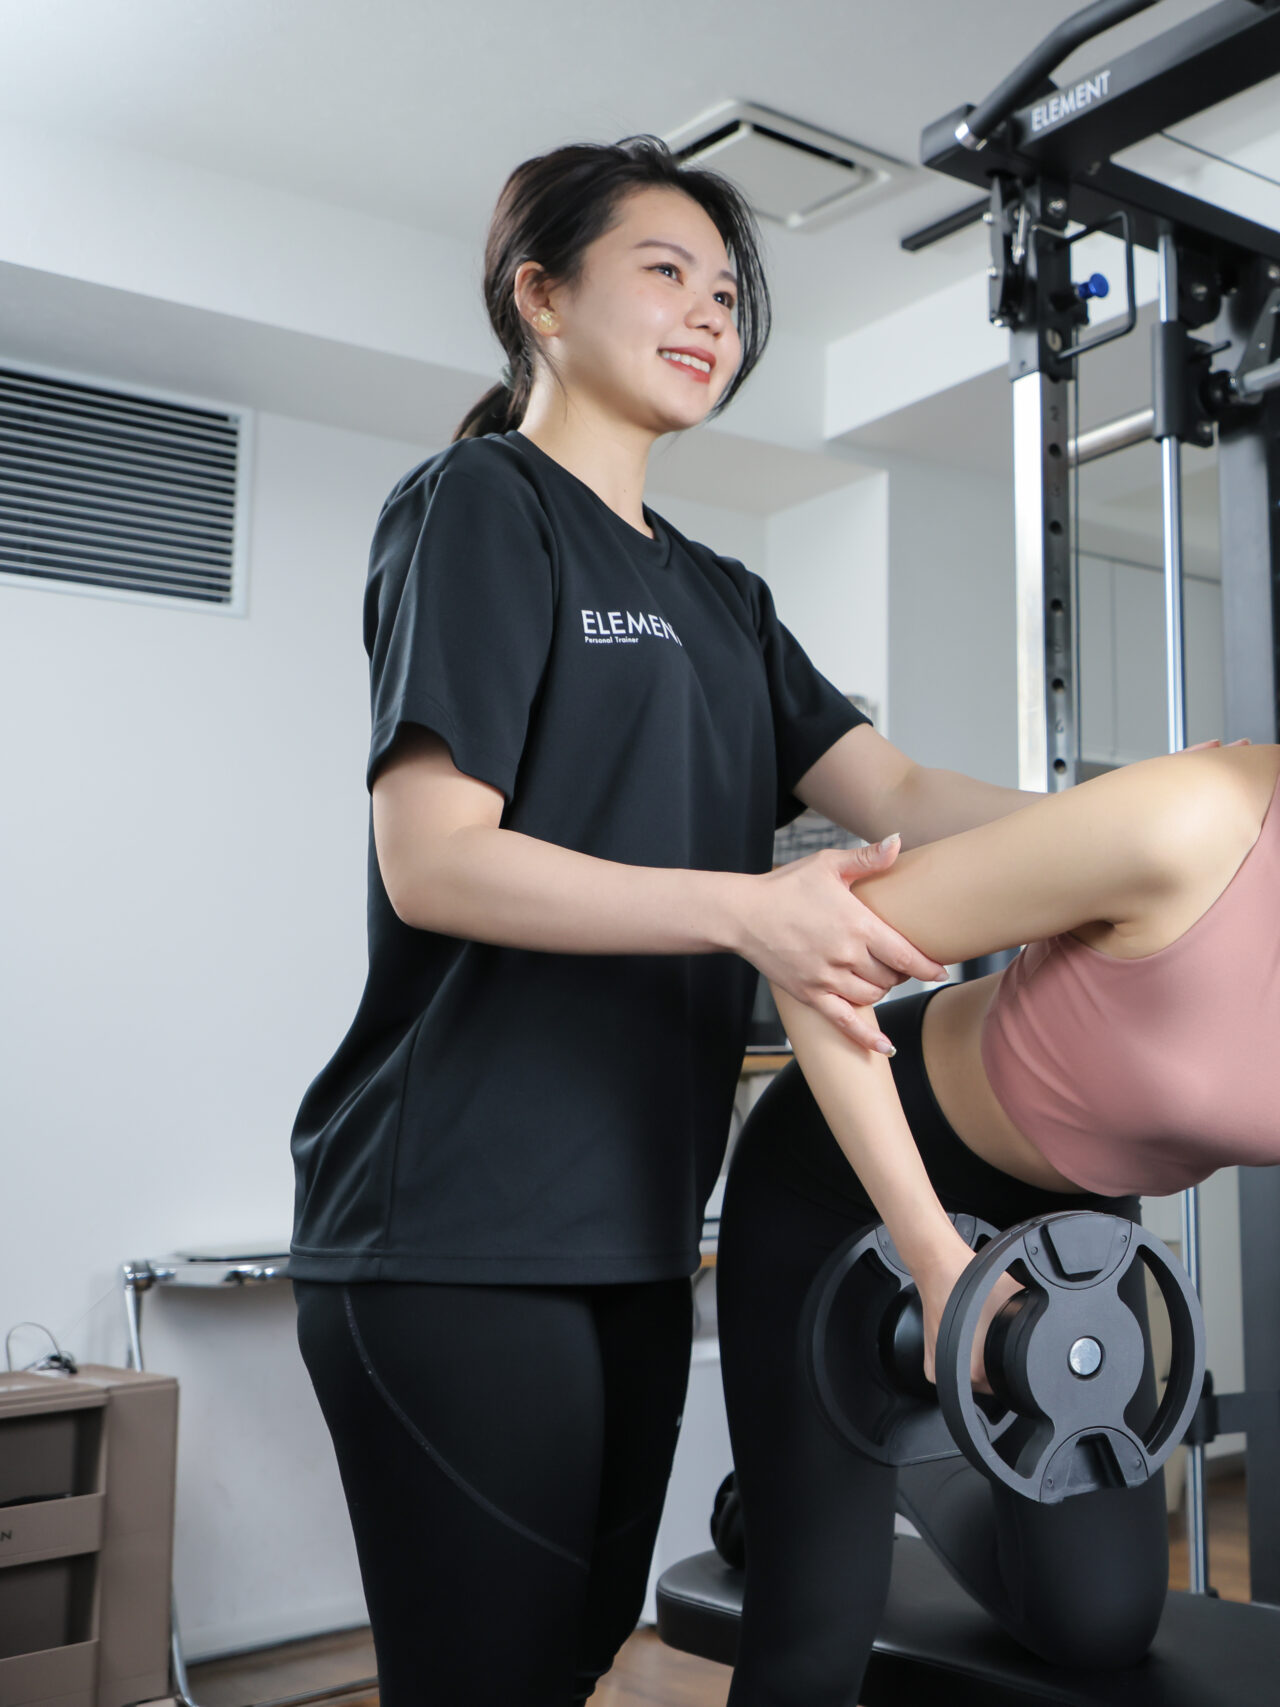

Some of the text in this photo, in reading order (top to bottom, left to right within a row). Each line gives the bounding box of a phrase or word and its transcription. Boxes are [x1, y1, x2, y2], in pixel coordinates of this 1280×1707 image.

[1031, 70, 1111, 132] ELEMENT
[581, 609, 683, 647] ELEMEN
[584, 636, 639, 644] Personal Trainer
